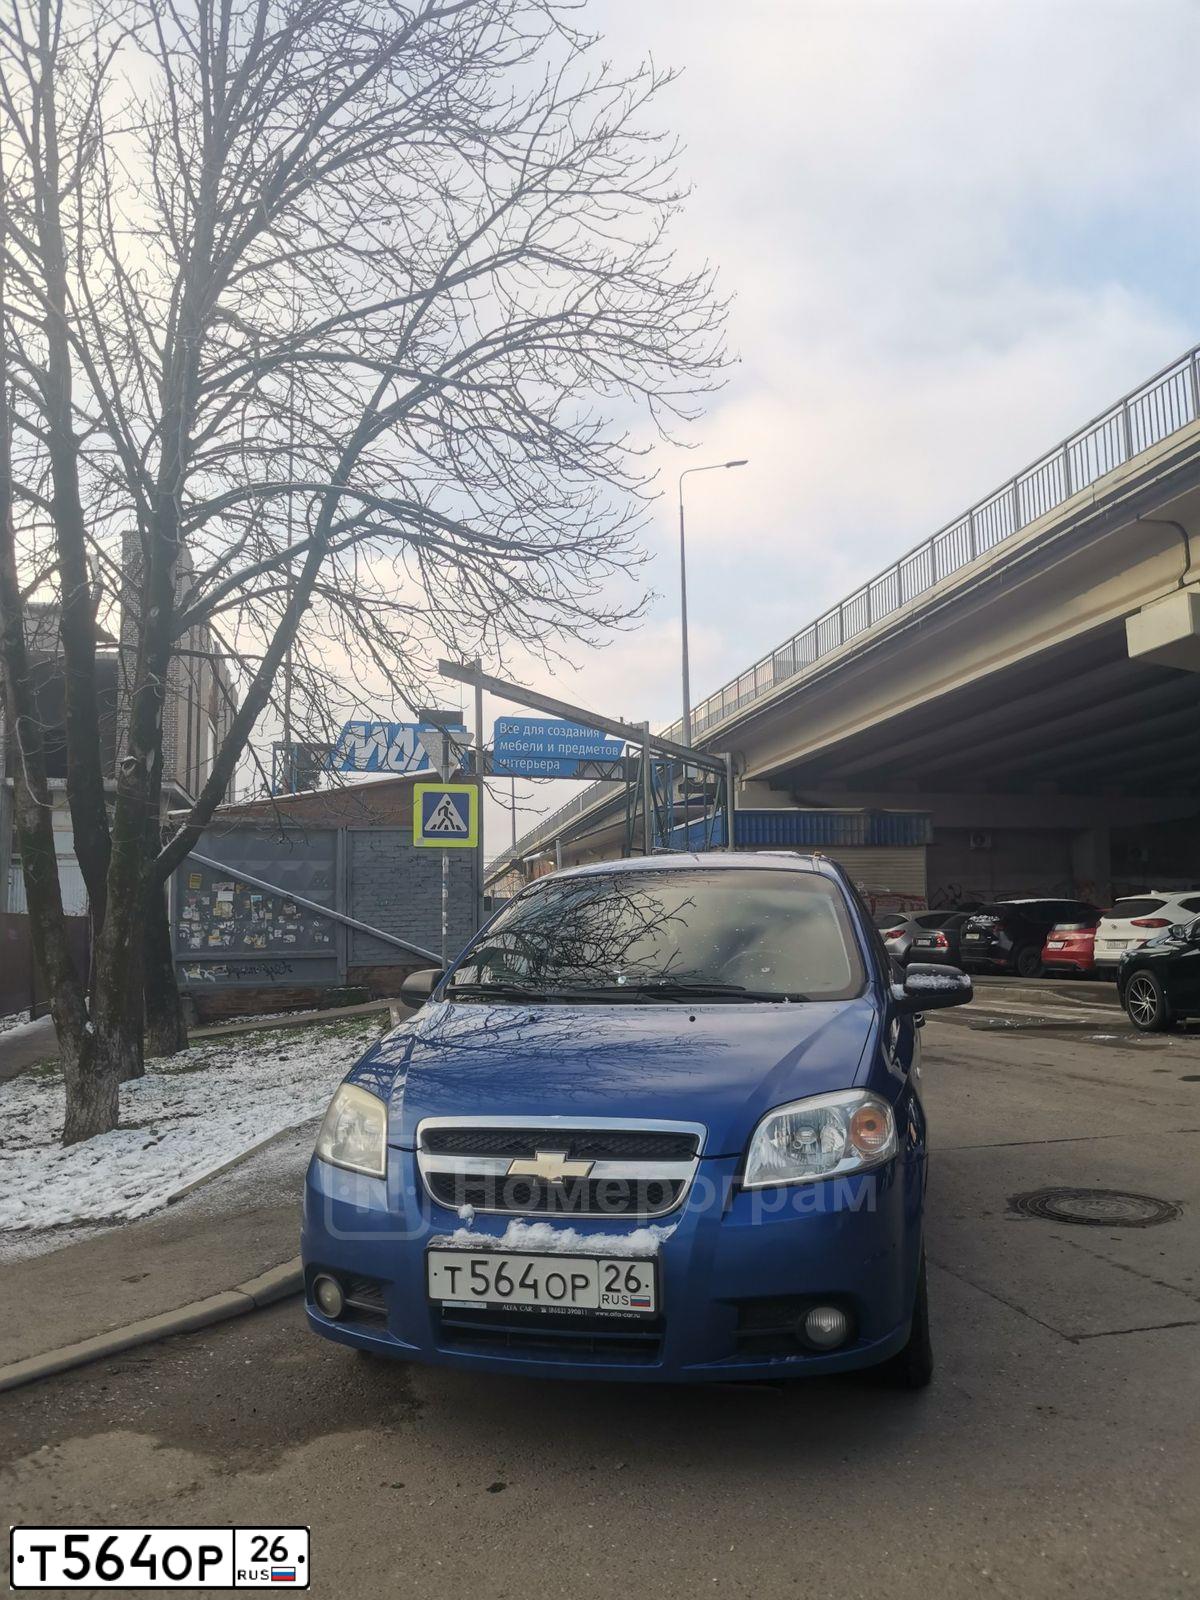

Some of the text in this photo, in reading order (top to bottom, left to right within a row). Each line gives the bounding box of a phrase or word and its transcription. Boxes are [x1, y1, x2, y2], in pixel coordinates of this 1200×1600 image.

[500, 722, 600, 739] Все для создания
[499, 739, 620, 756] мебели и предметов
[604, 1264, 642, 1294] 26
[601, 1294, 629, 1306] RUS
